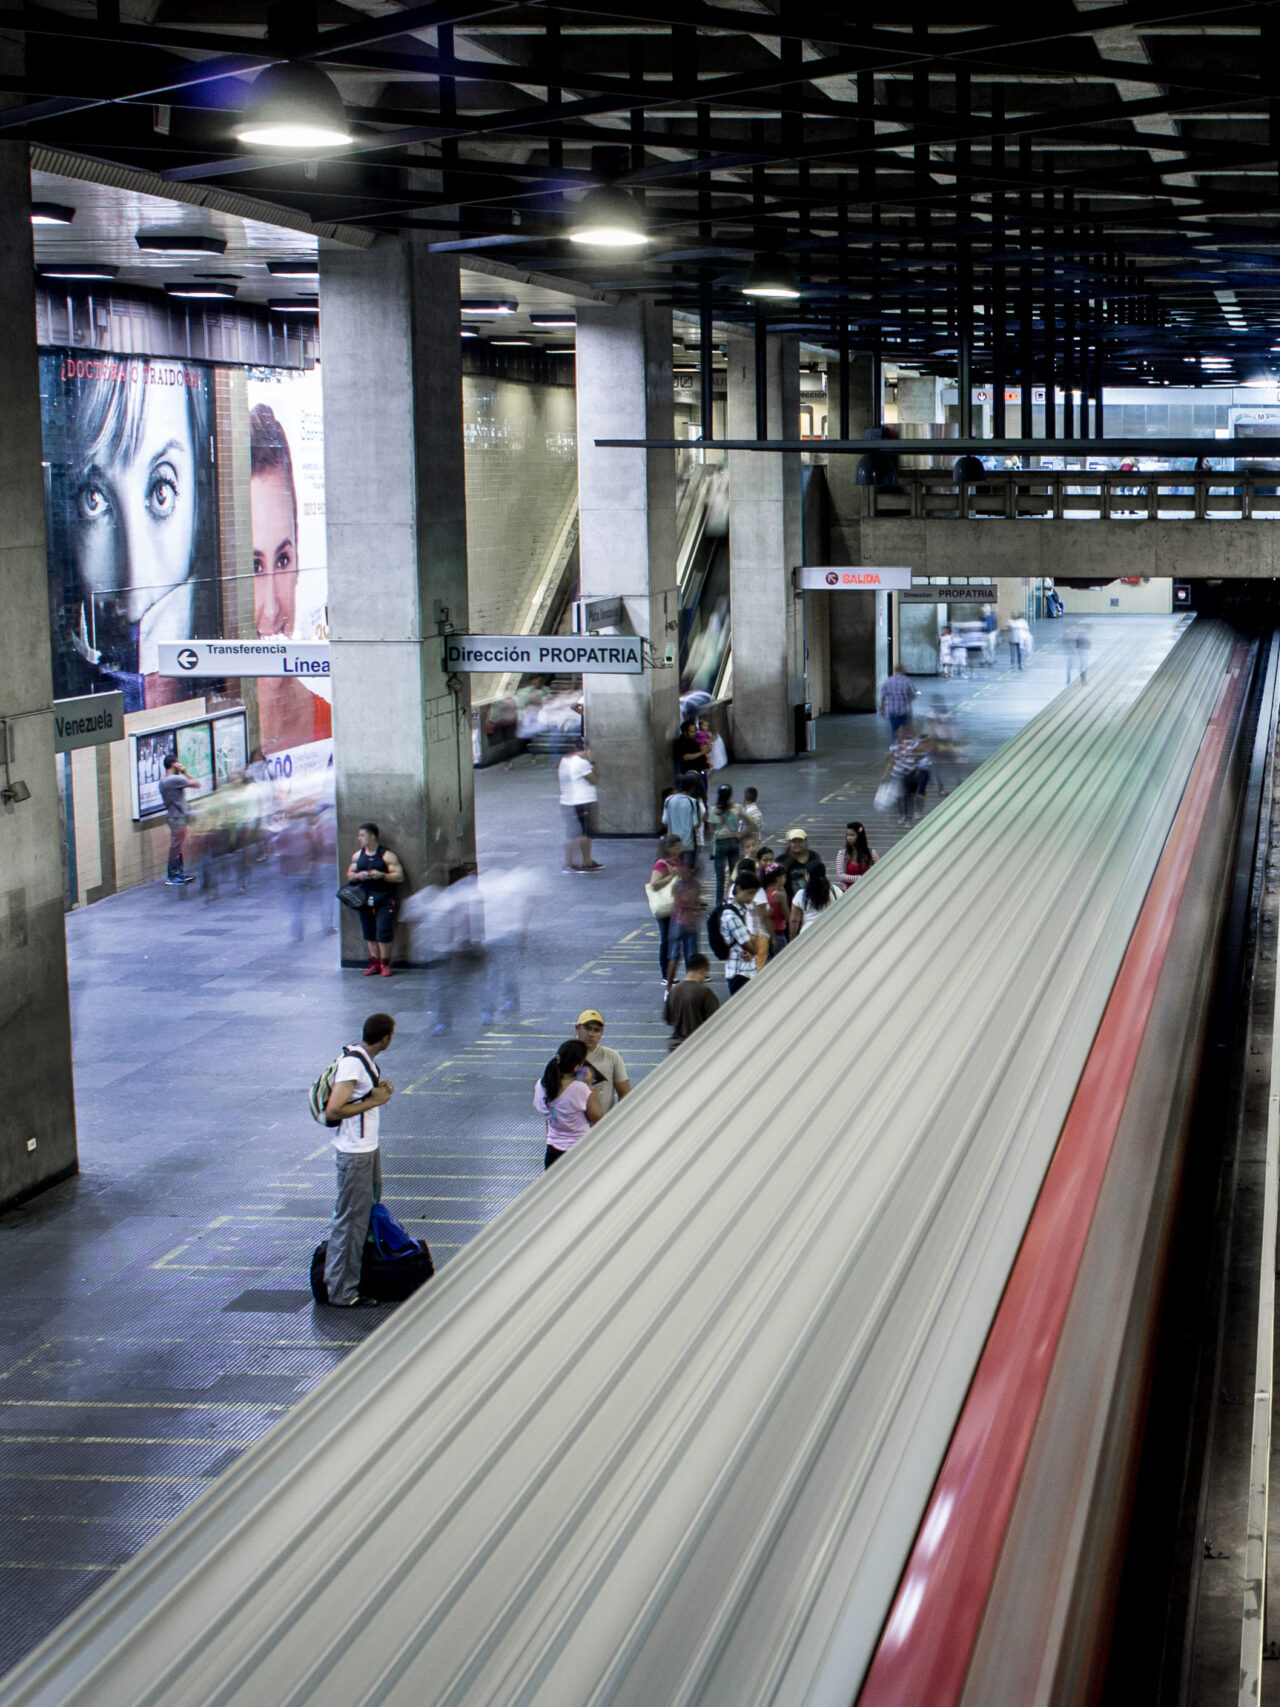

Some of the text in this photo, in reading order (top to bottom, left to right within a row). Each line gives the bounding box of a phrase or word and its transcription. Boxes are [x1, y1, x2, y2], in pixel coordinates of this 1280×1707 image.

[130, 366, 138, 382] O
[842, 574, 881, 584] SALIDA
[938, 590, 994, 599] PROPATRIA
[206, 644, 287, 654] Transferencia
[449, 644, 638, 663] Dirección PROPATRIA
[55, 709, 113, 738] Venezuela
